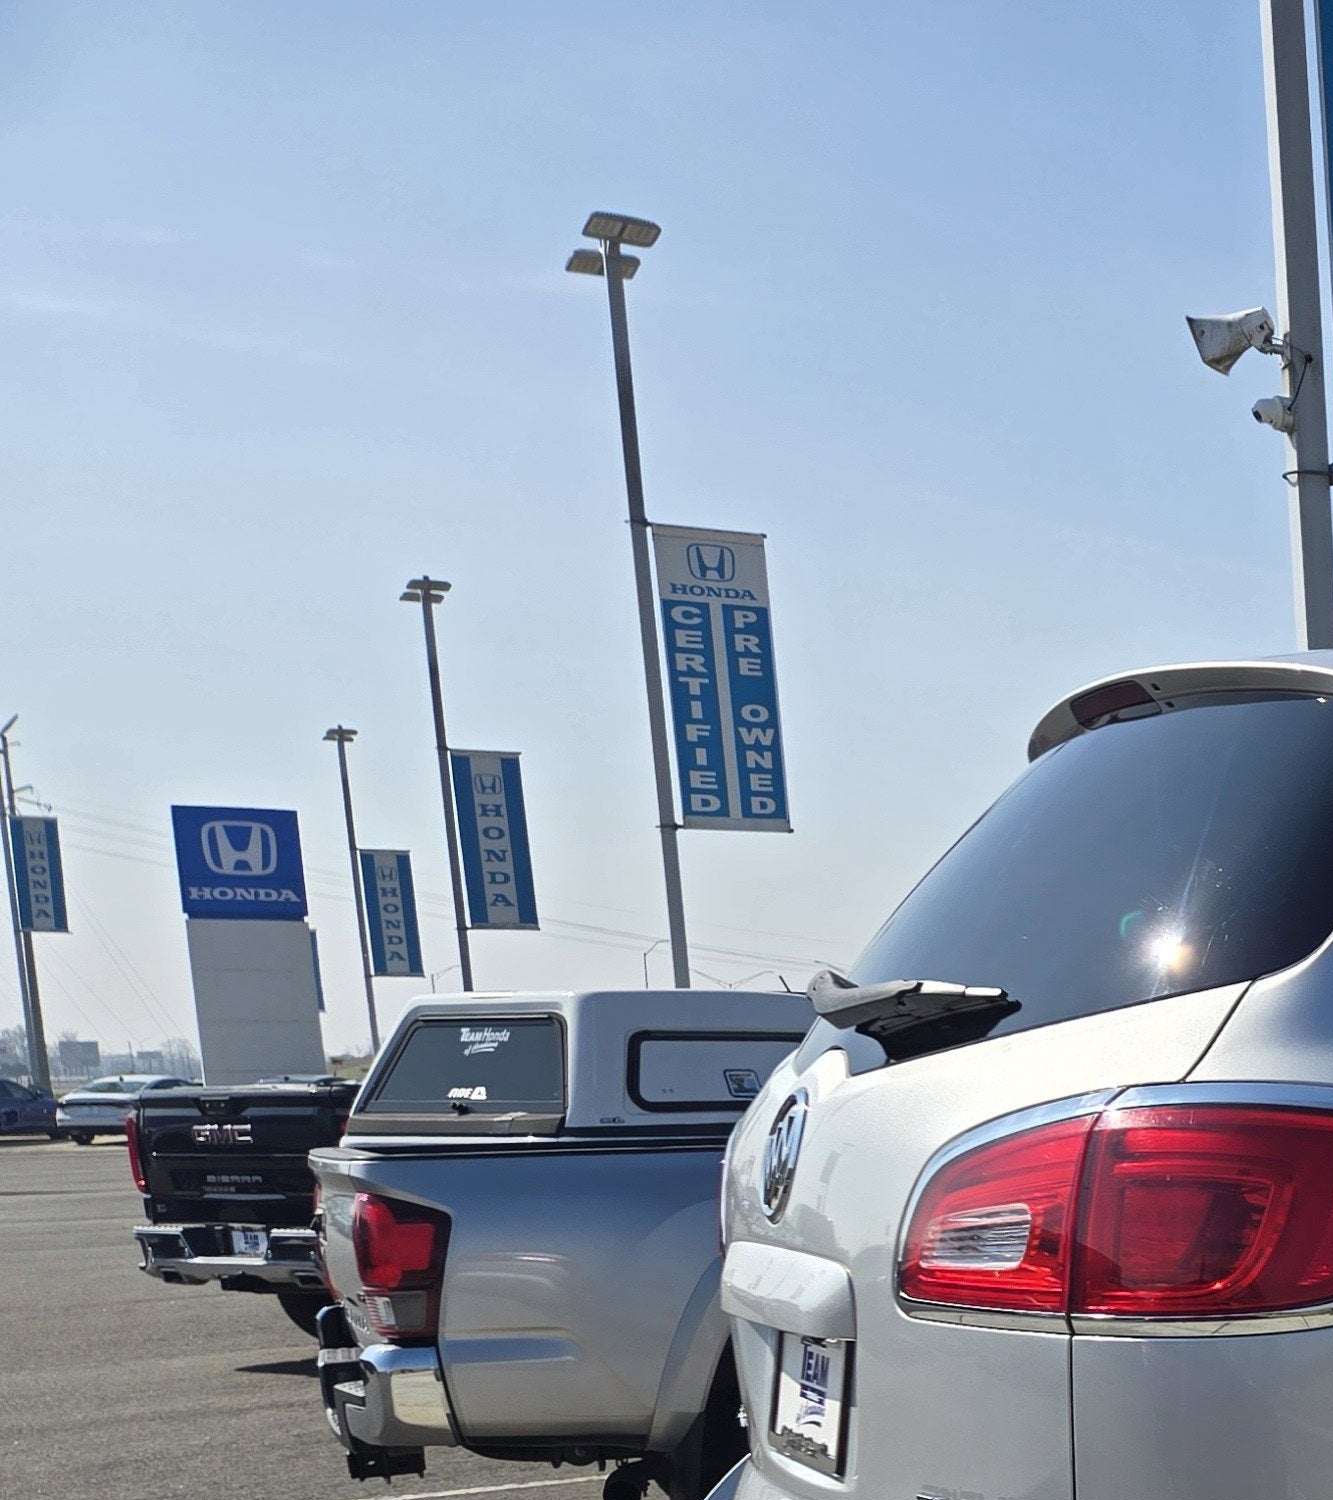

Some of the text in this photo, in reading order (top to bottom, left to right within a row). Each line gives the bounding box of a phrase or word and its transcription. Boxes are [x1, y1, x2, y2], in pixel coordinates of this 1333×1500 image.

[668, 582, 758, 601] HONDA
[670, 604, 722, 813] CERTIFIED
[733, 609, 777, 816] PRE OWNED
[29, 851, 51, 919] HONDA
[477, 803, 516, 907] HONDA
[188, 886, 301, 903] HONDA
[379, 886, 407, 962] HONDA
[192, 1124, 253, 1145] GMC
